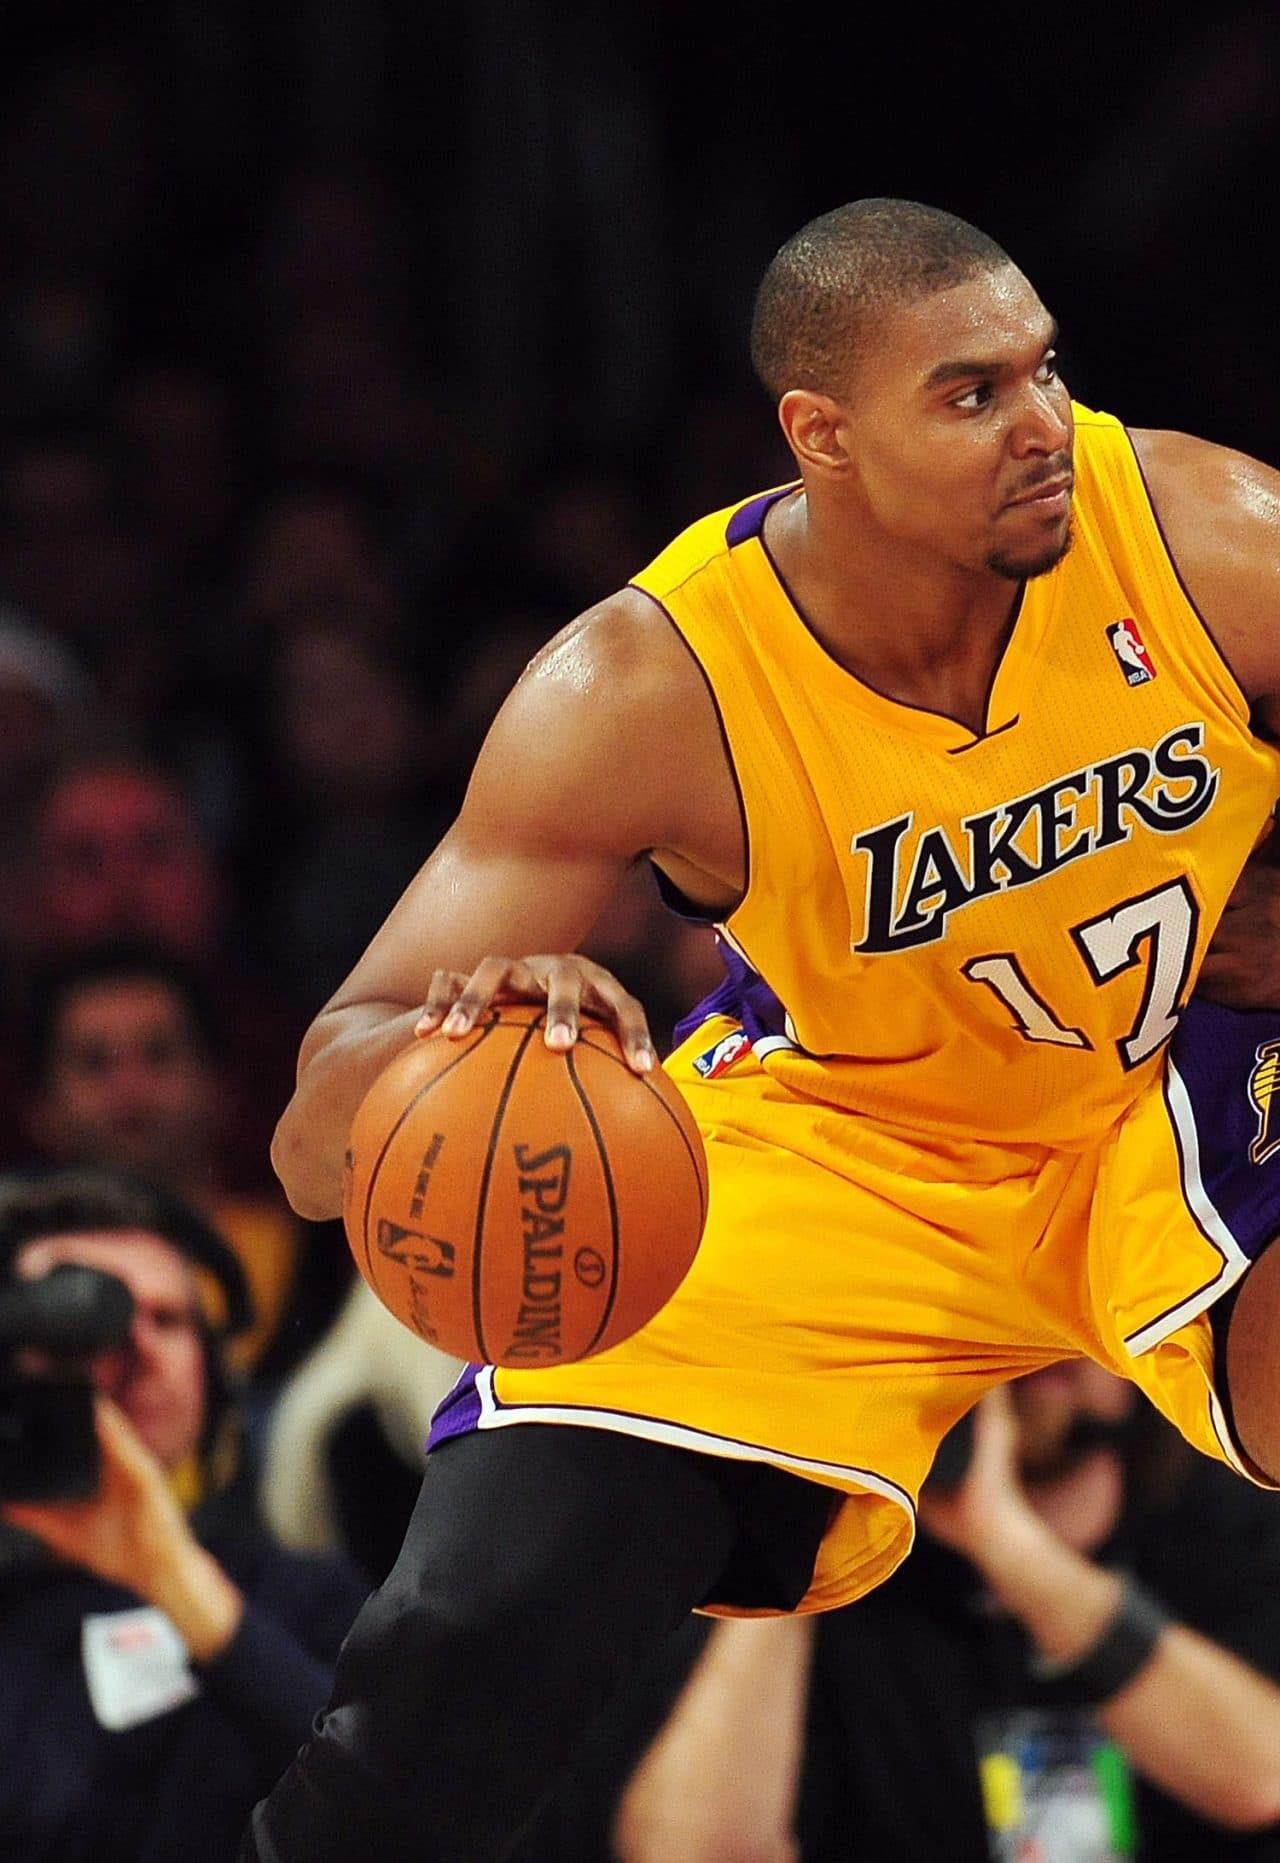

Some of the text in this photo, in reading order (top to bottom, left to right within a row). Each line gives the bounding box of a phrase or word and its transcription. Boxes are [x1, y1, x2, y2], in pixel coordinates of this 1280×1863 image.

[850, 722, 1221, 956] LAKERS
[959, 874, 1200, 1073] 17
[505, 1142, 572, 1358] SPALDING
